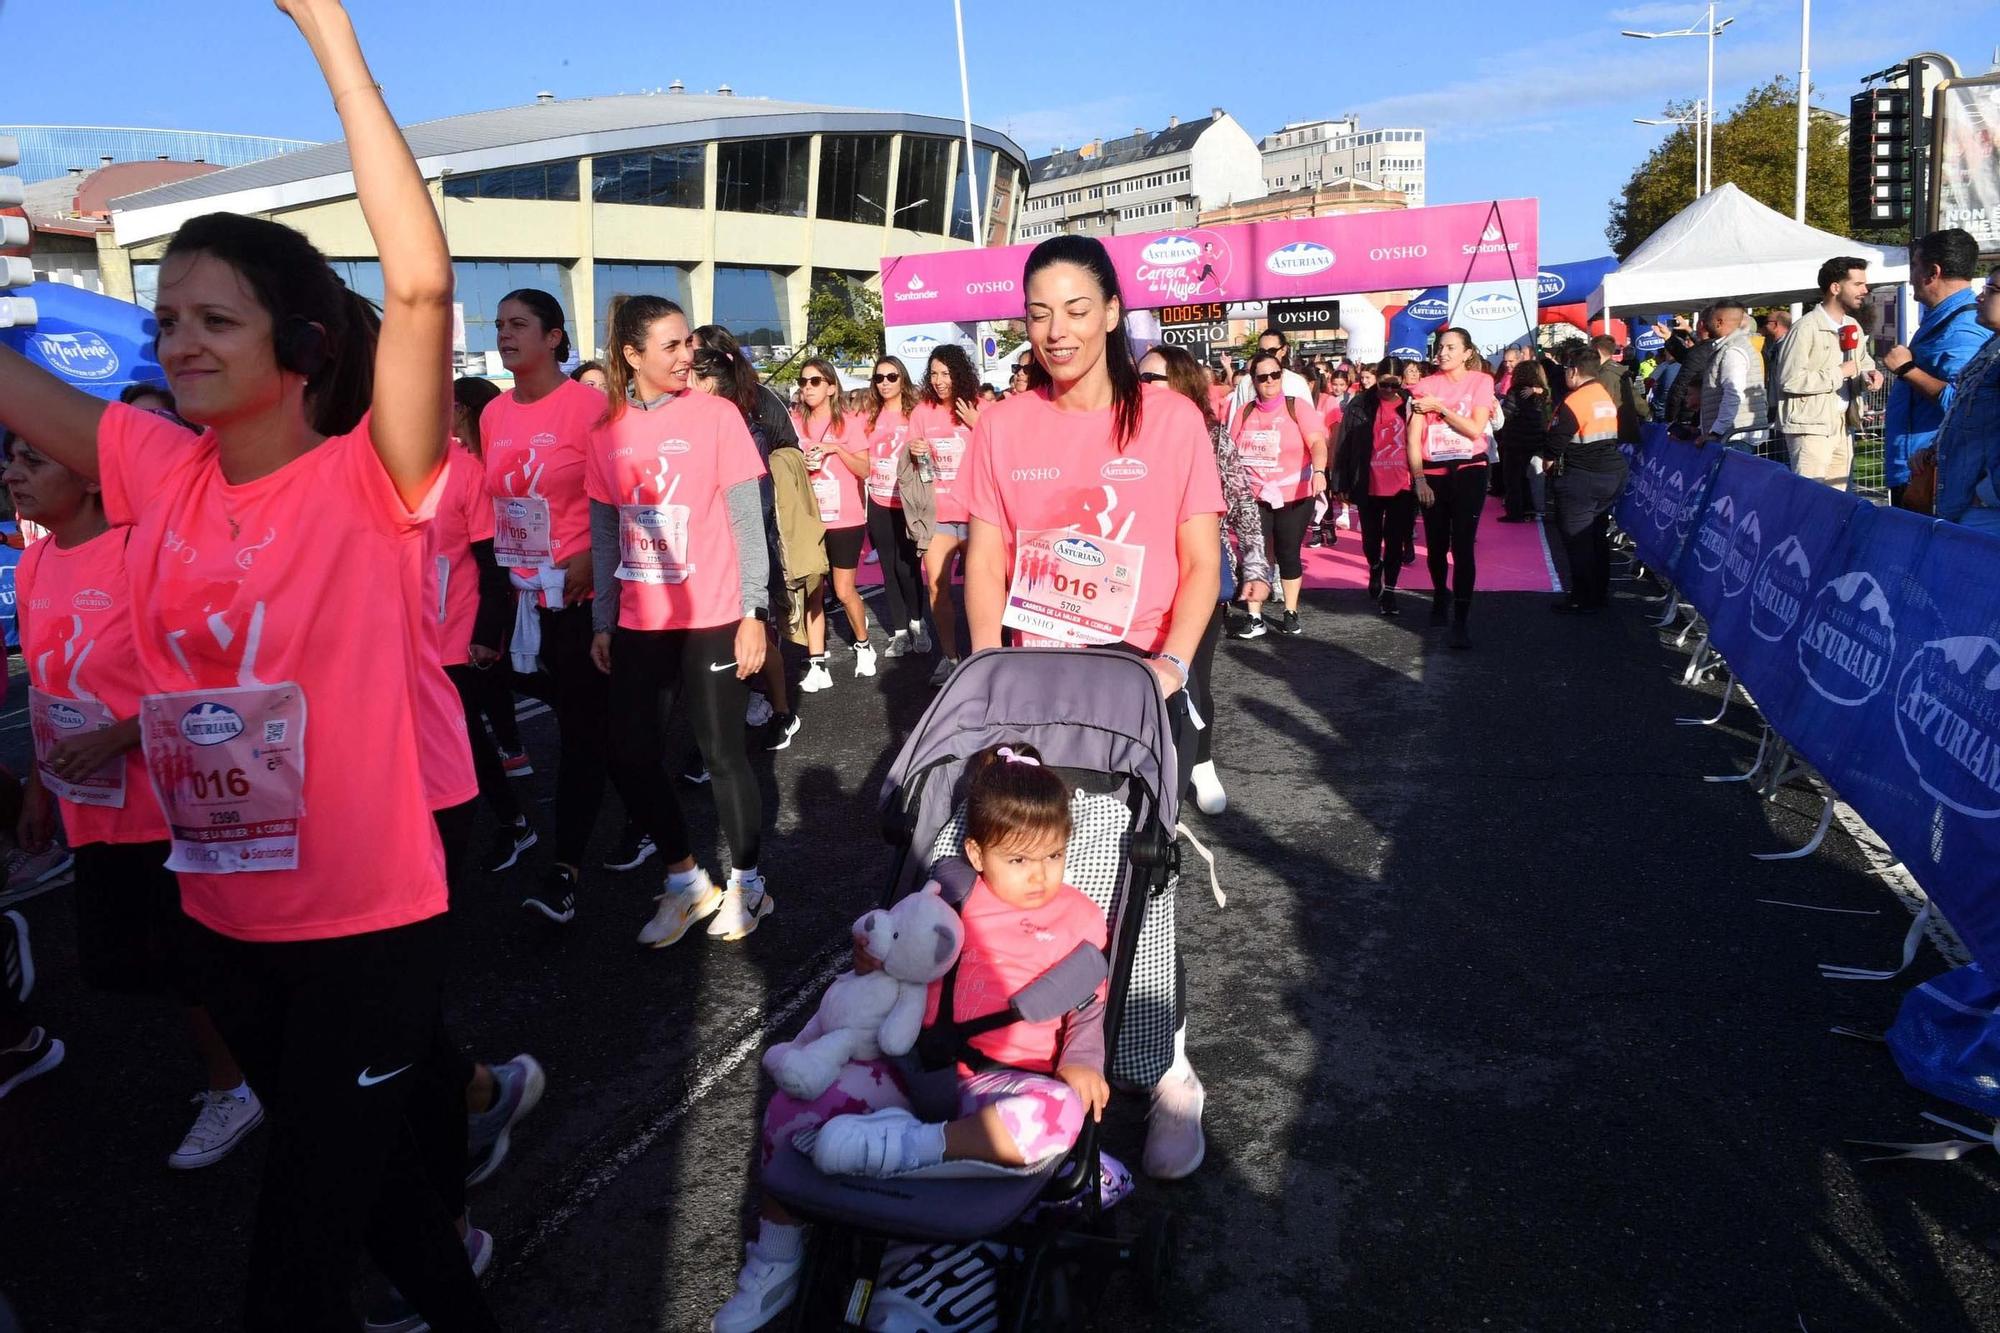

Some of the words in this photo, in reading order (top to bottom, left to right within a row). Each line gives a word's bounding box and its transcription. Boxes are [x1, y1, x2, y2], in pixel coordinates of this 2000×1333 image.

[1147, 247, 1198, 260] ASTURIANA
[1369, 244, 1428, 261] OYSHO
[1463, 241, 1520, 255] Santander
[1270, 253, 1332, 270] ASTURIANA
[1136, 265, 1187, 281] Carrera
[966, 279, 1014, 295] OYSHO
[1165, 277, 1203, 301] Mujer
[894, 289, 939, 301] Santander
[1163, 304, 1222, 323] 00:05:15
[1277, 310, 1330, 324] OYSHO
[1469, 304, 1519, 316] ASTURIANA
[1163, 327, 1225, 345] OYSHO
[41, 340, 110, 366] Marlene
[936, 455, 953, 463] 016
[1011, 467, 1061, 481] OYSHO
[510, 527, 527, 540] 016
[640, 538, 668, 552] 016
[1057, 543, 1102, 564] ASTURIANA
[1053, 574, 1098, 600] 016
[1060, 601, 1082, 613] 5702
[1017, 612, 1054, 631] OYSHO
[184, 721, 239, 735] ASTURIANA
[193, 767, 250, 799] 016
[209, 810, 240, 825] 2390
